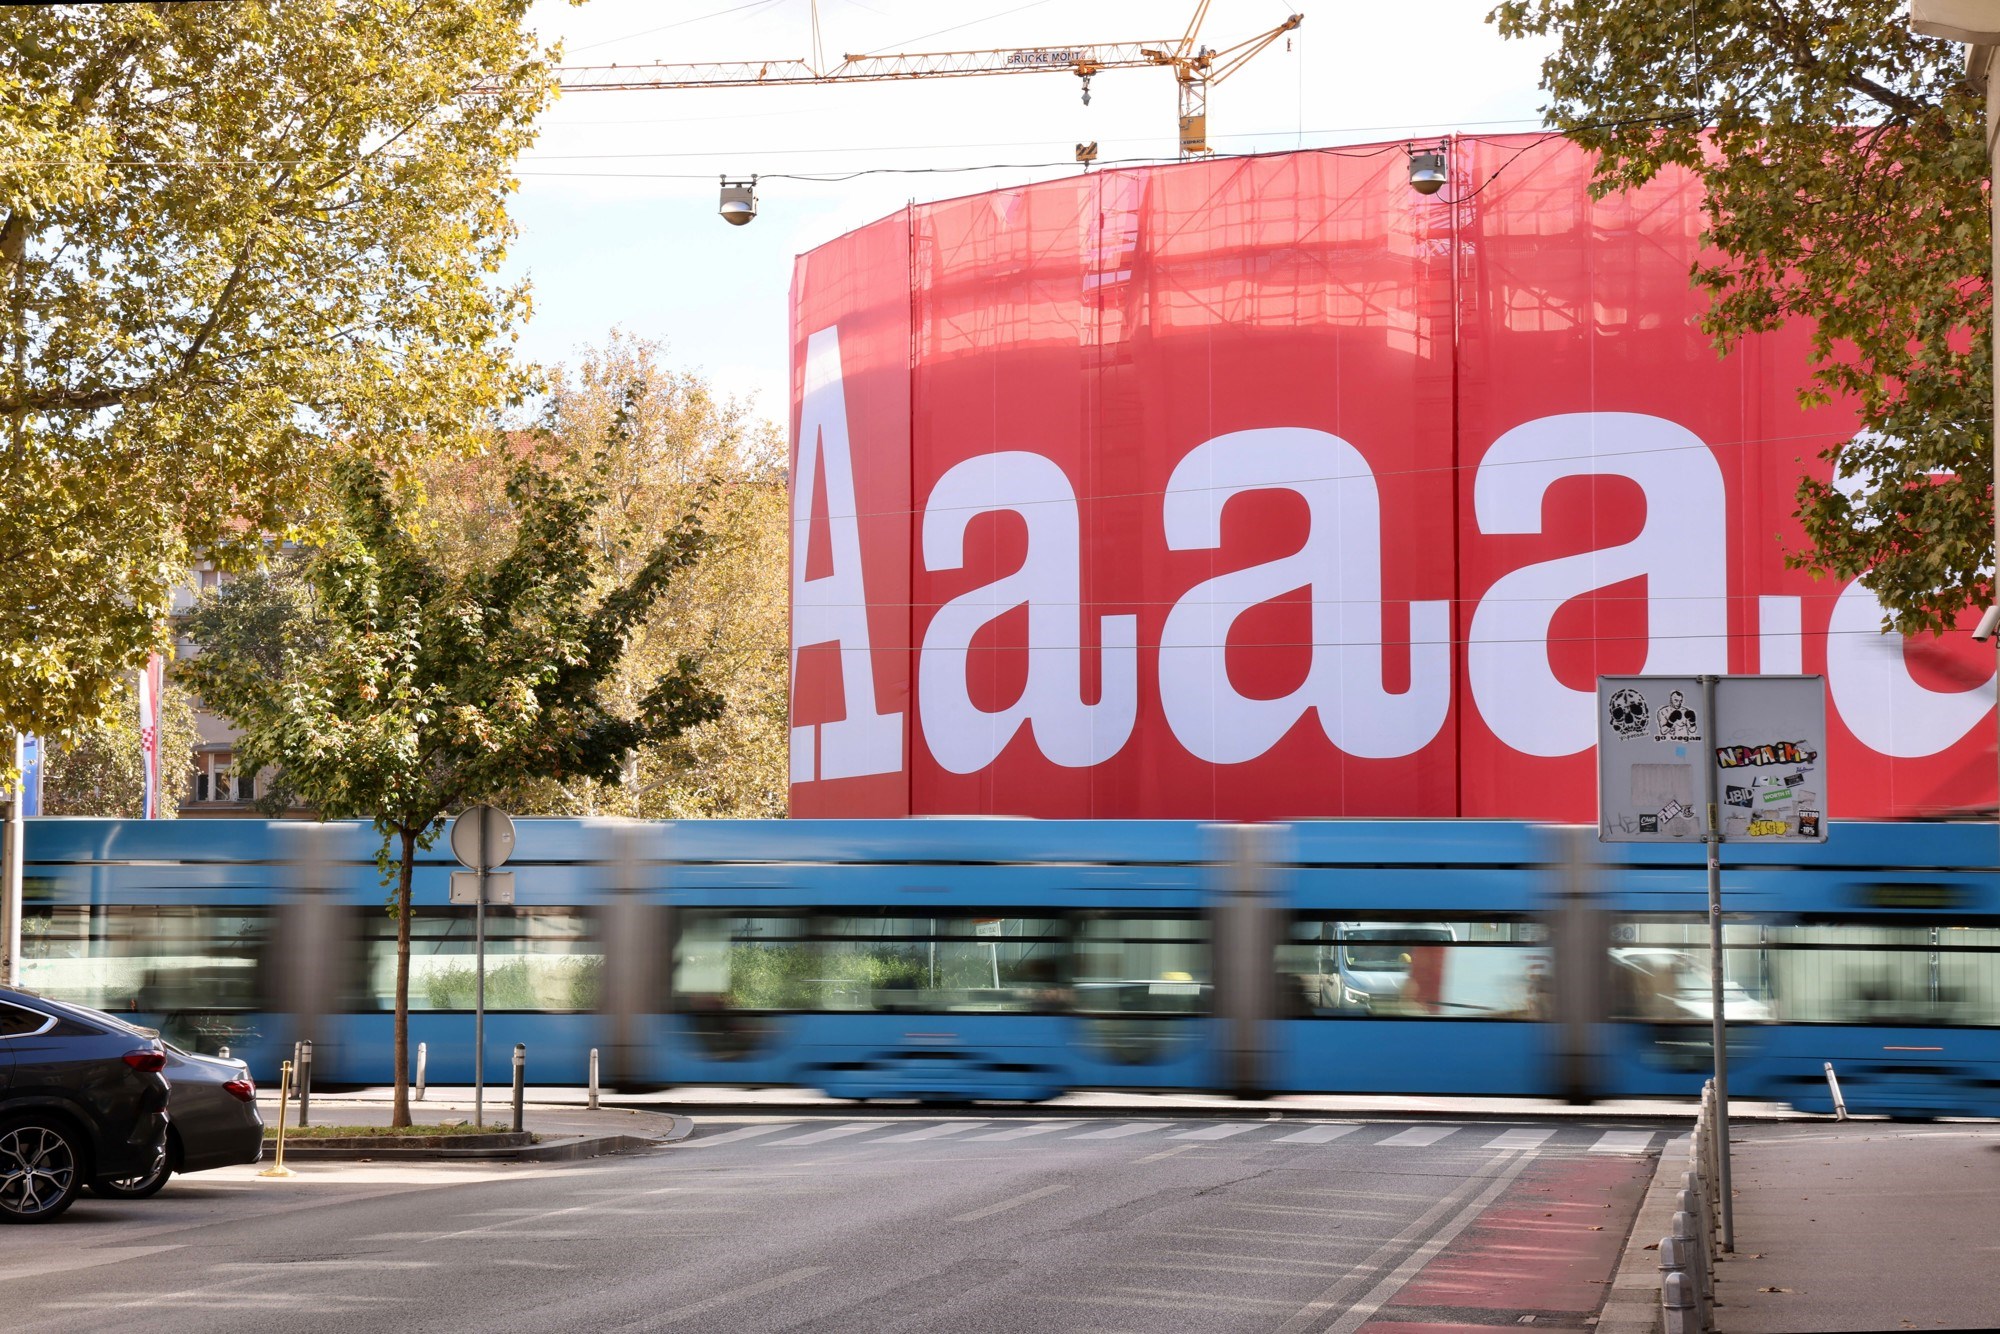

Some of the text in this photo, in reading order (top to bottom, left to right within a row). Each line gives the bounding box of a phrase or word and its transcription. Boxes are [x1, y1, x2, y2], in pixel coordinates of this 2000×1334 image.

[1670, 735, 1702, 743] vegan
[1718, 746, 1776, 768] NEMA
[1763, 791, 1785, 800] WORTH
[1800, 826, 1816, 834] -10%
